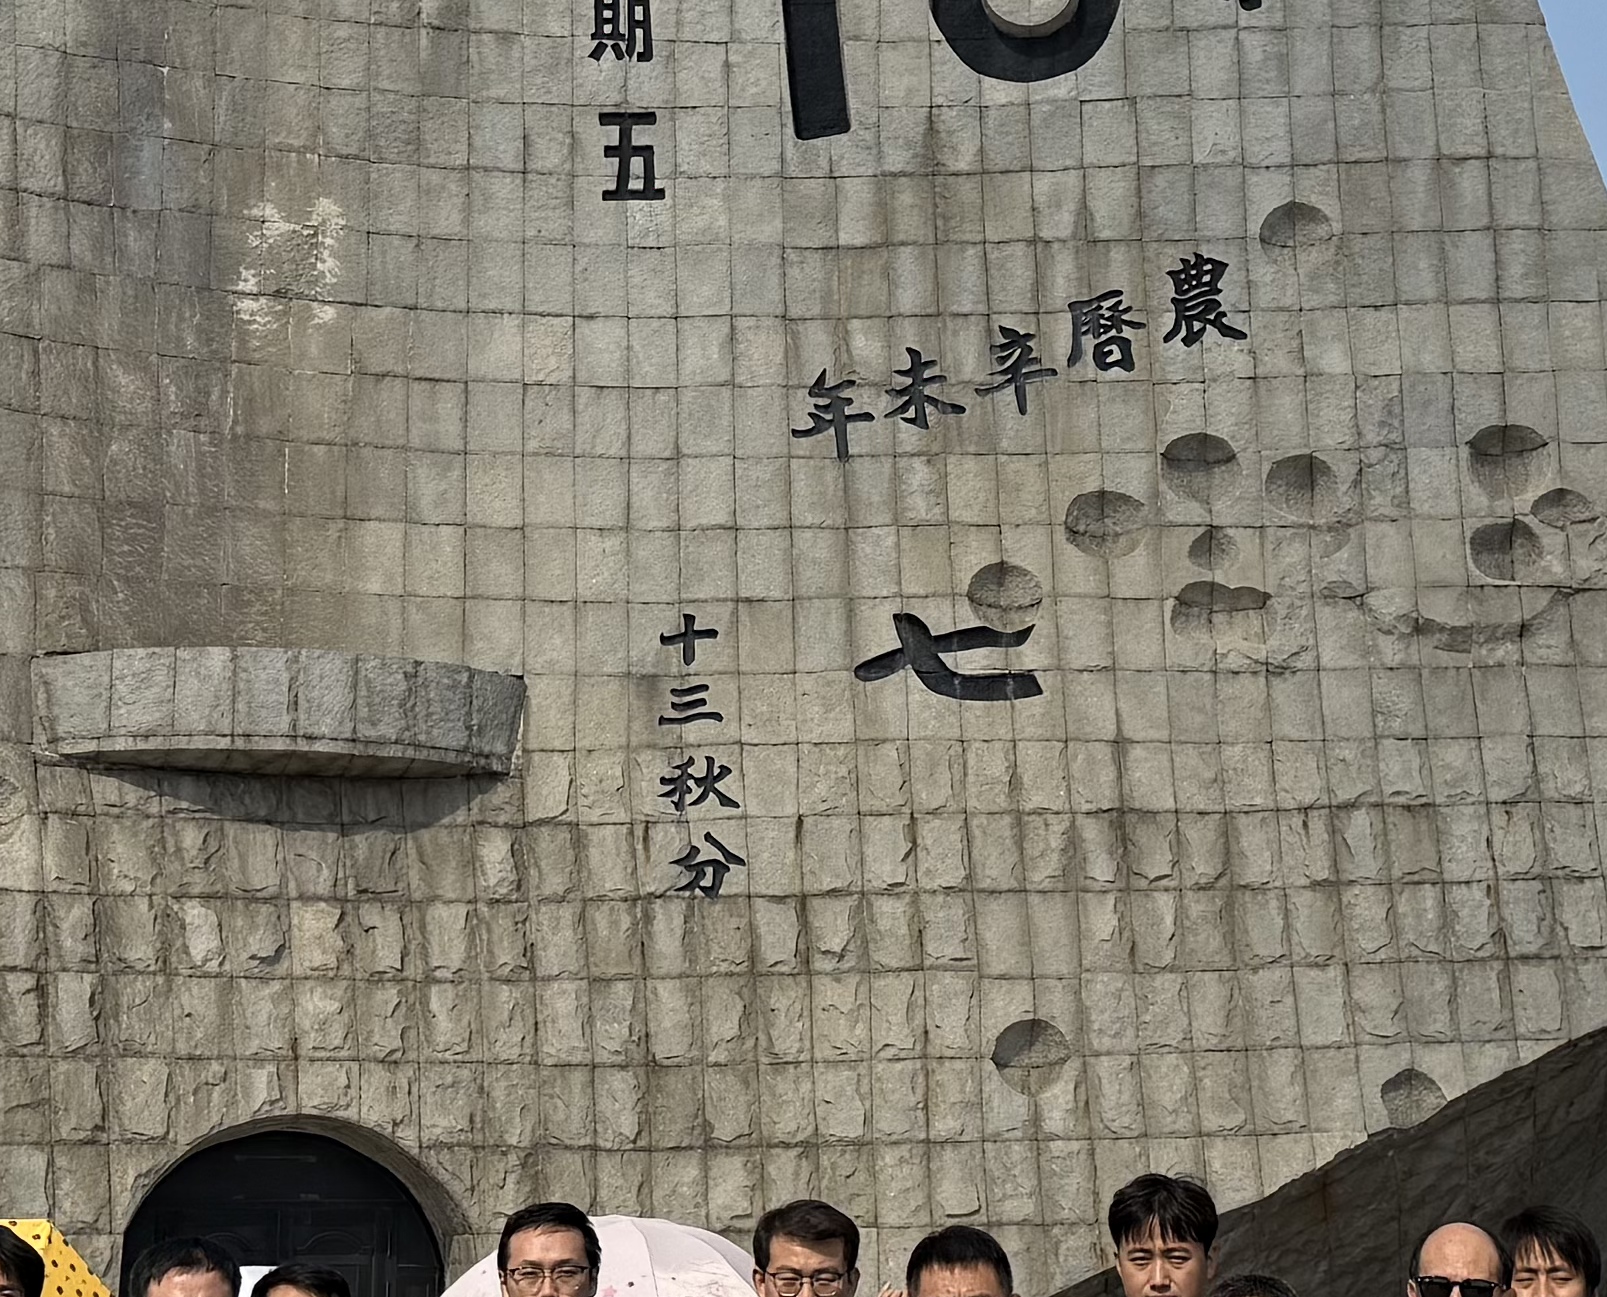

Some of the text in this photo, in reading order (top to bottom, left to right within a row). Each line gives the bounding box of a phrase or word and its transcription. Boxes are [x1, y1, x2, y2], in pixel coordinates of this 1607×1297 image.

[854, 612, 1044, 702] 七
[658, 614, 746, 899] 十三秋分
